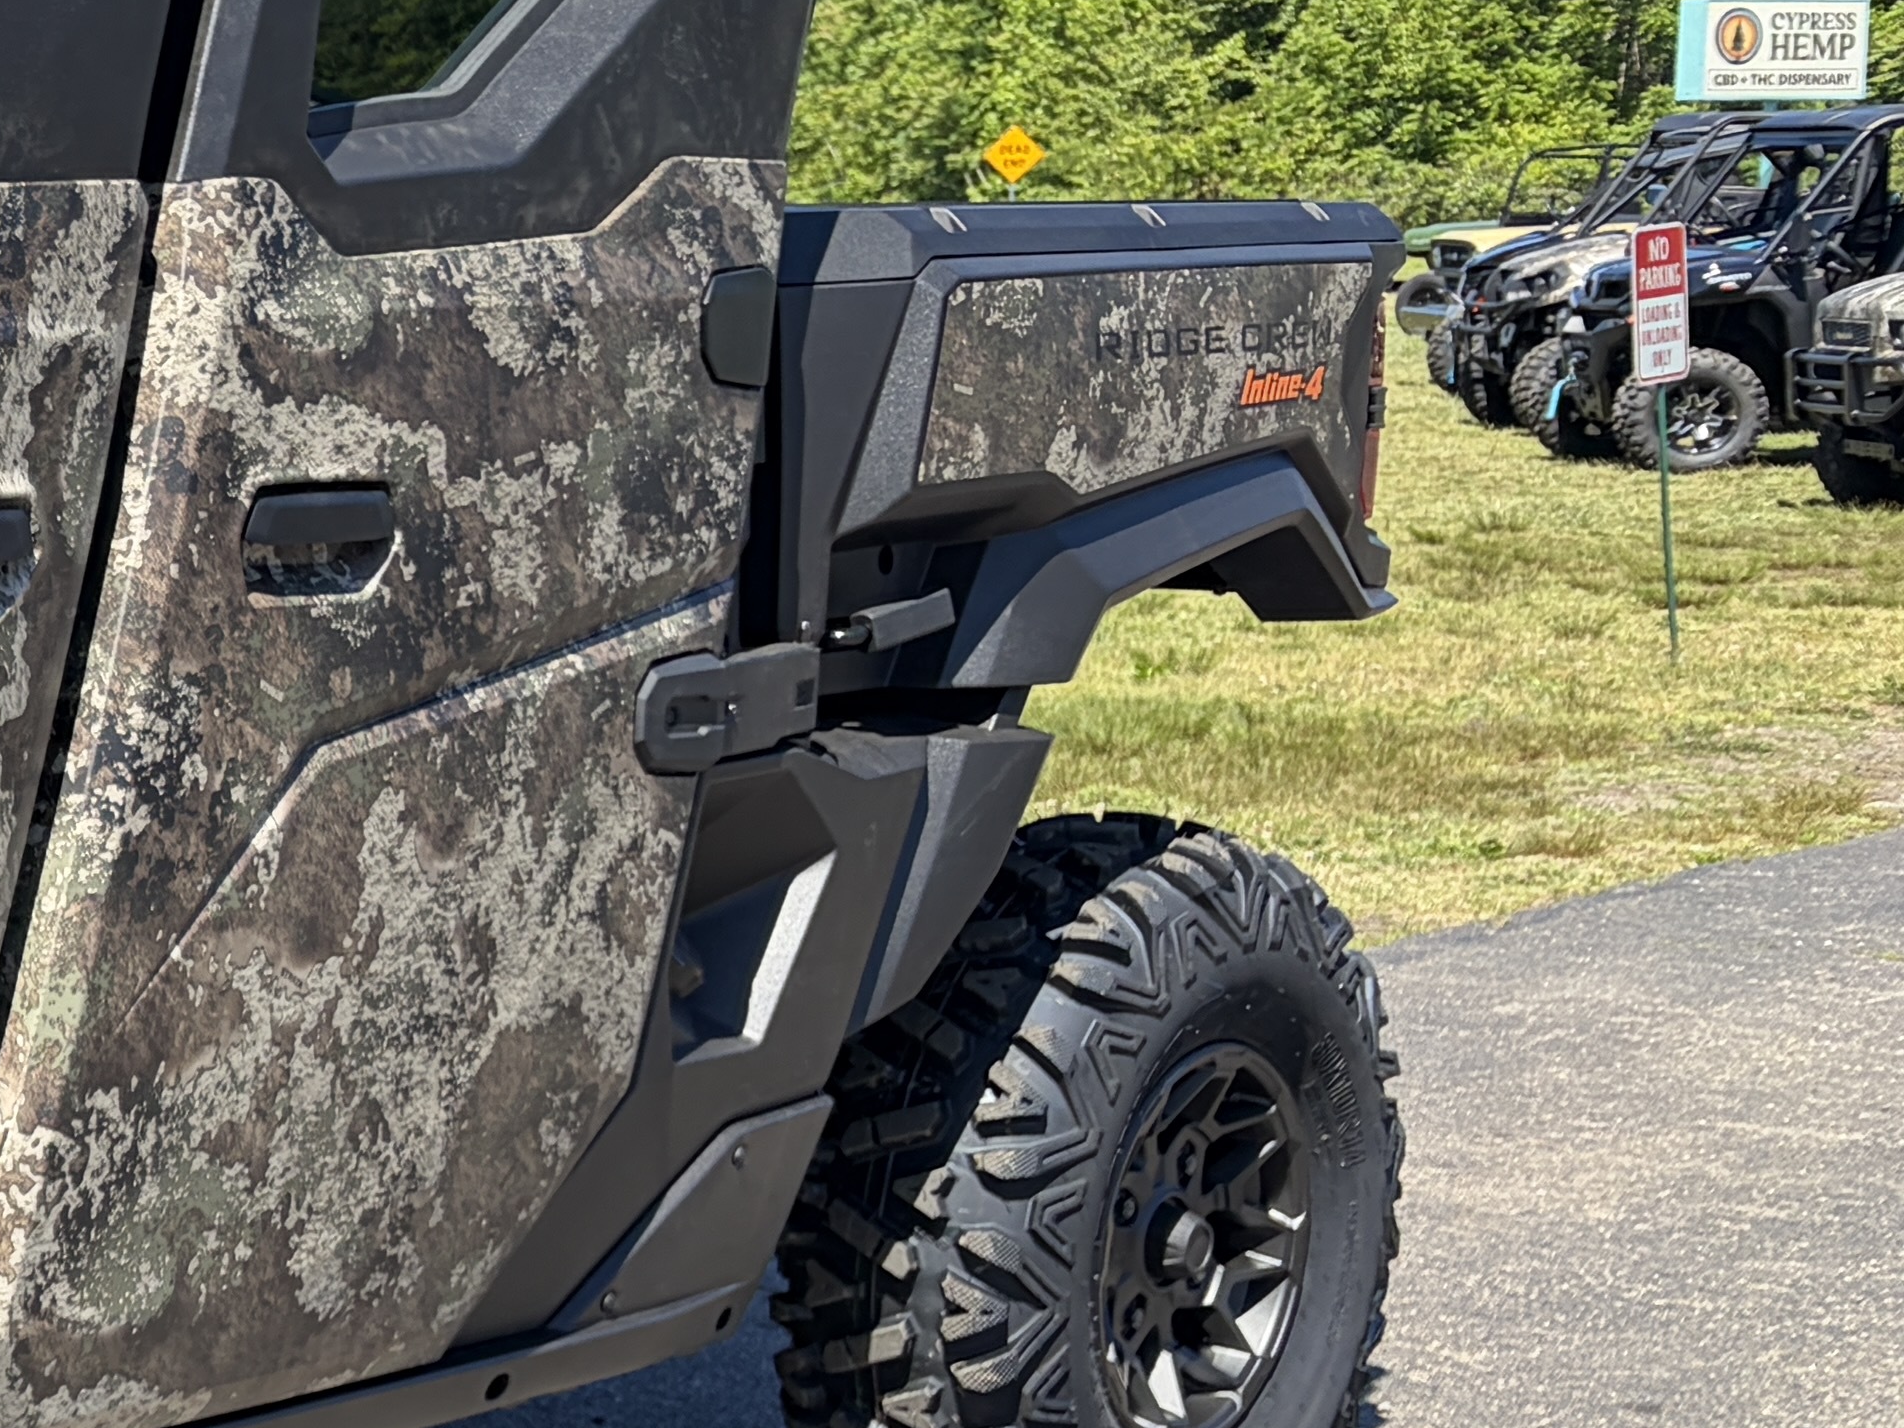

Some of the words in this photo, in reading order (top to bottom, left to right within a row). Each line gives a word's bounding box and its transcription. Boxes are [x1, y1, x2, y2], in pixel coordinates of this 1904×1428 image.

[1771, 12, 1857, 30] CYPRESS
[1769, 33, 1857, 61] HEMP
[1713, 74, 1738, 86] CBD
[1751, 74, 1775, 86] THC
[1778, 73, 1852, 86] DISPENSARY
[1648, 236, 1670, 262] NO
[1639, 262, 1681, 292] PARKING
[1095, 325, 1226, 362] RIDGE
[1242, 319, 1333, 353] CREW
[1239, 362, 1328, 407] Inline-4
